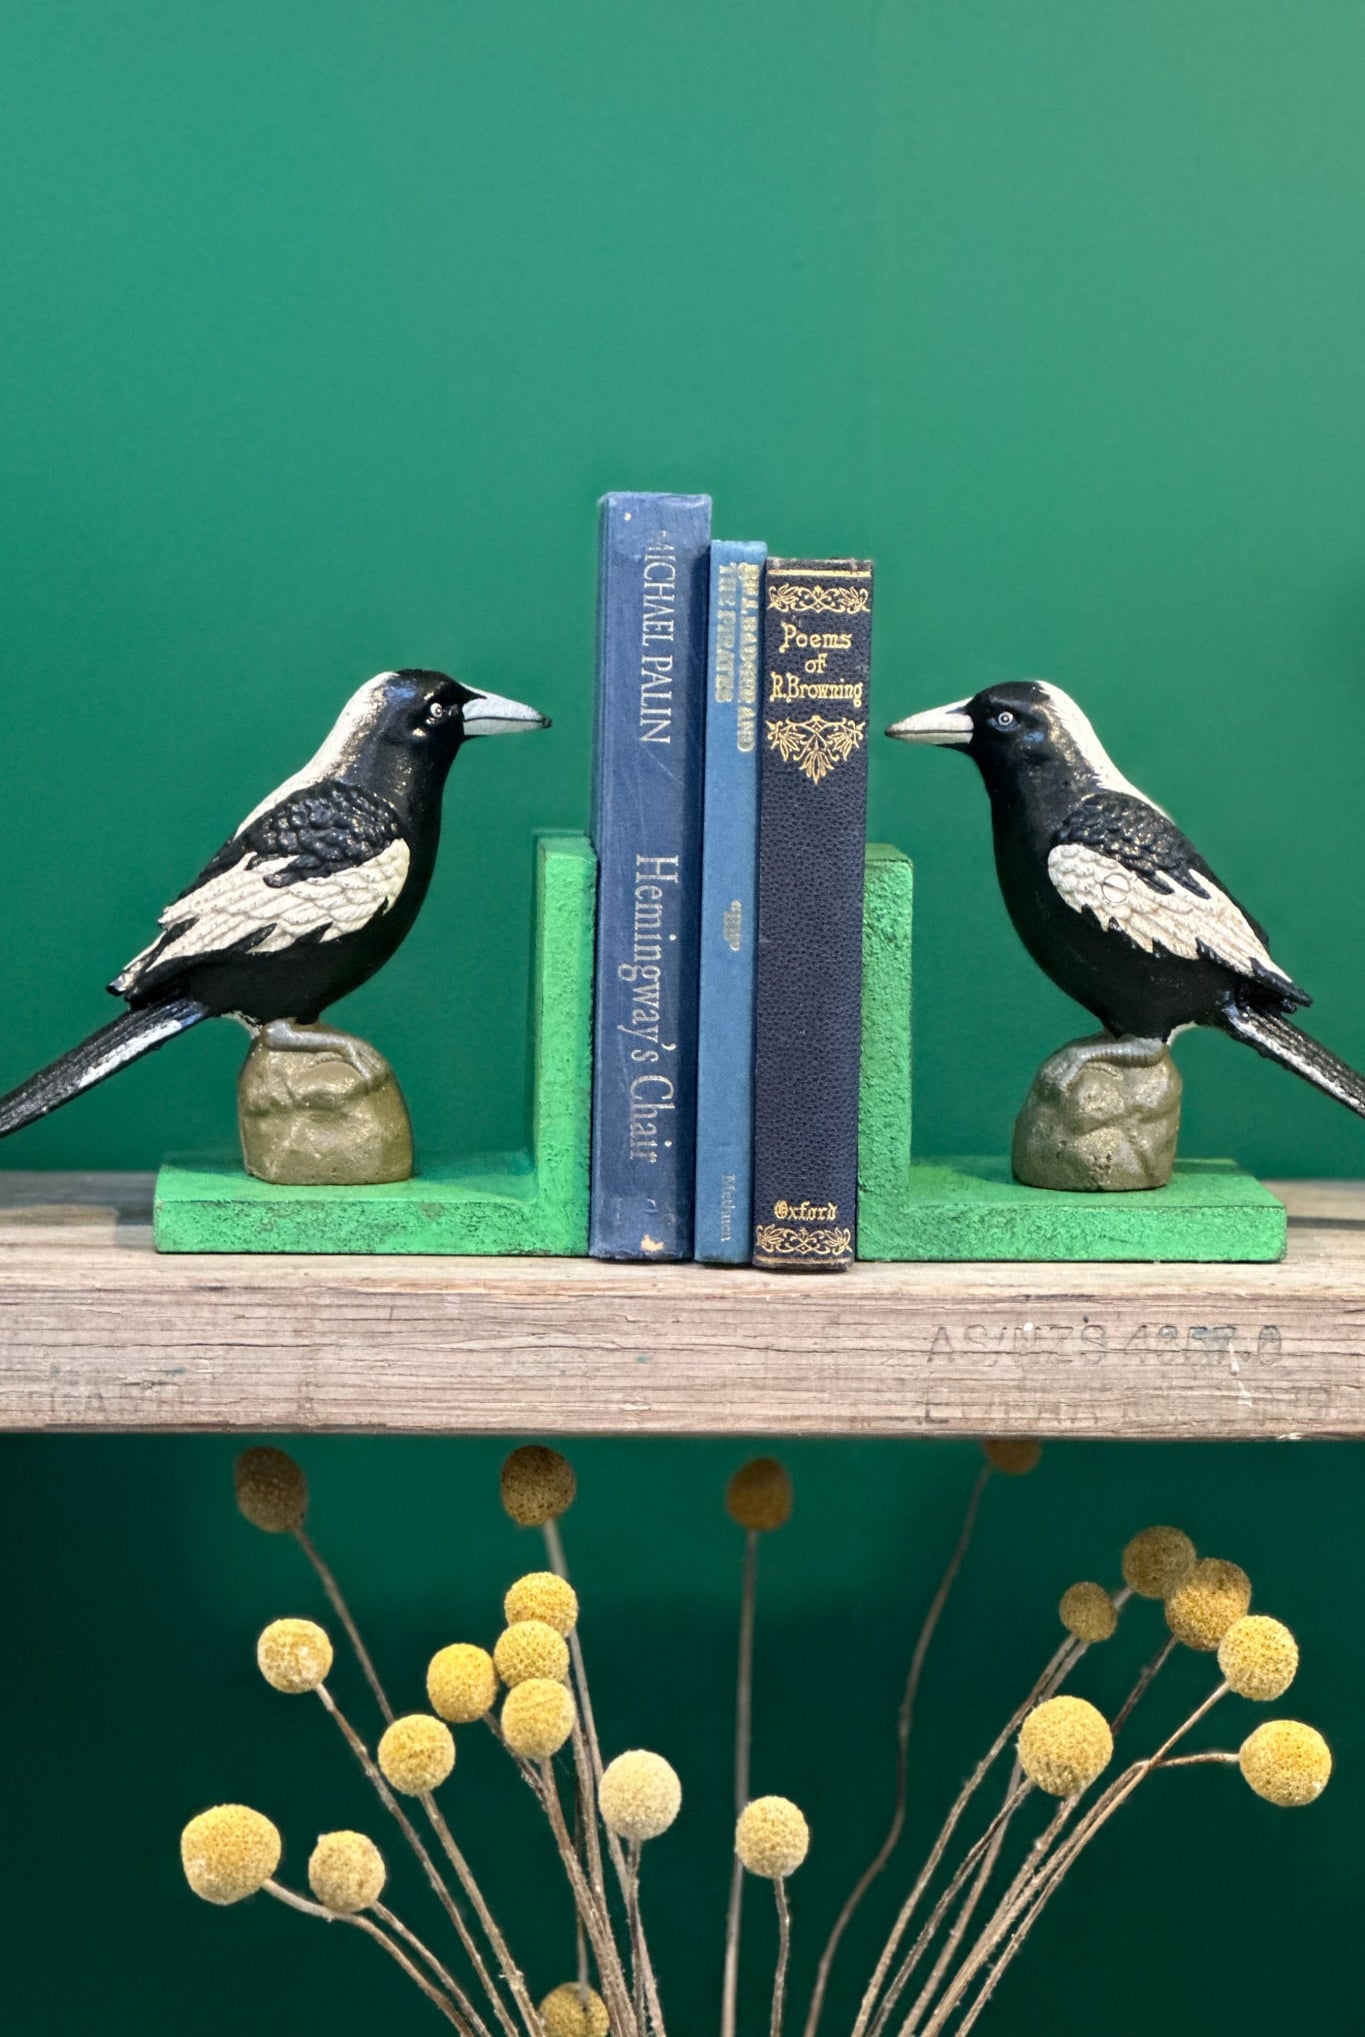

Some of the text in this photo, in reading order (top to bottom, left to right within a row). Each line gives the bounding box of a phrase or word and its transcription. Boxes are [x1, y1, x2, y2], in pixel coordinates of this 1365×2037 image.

[779, 621, 852, 653] Poems
[805, 653, 828, 674] of
[639, 655, 673, 744] PALIN
[618, 854, 679, 1062] Hemingway's
[630, 1075, 676, 1163] Chair
[774, 1200, 838, 1221] Oxford
